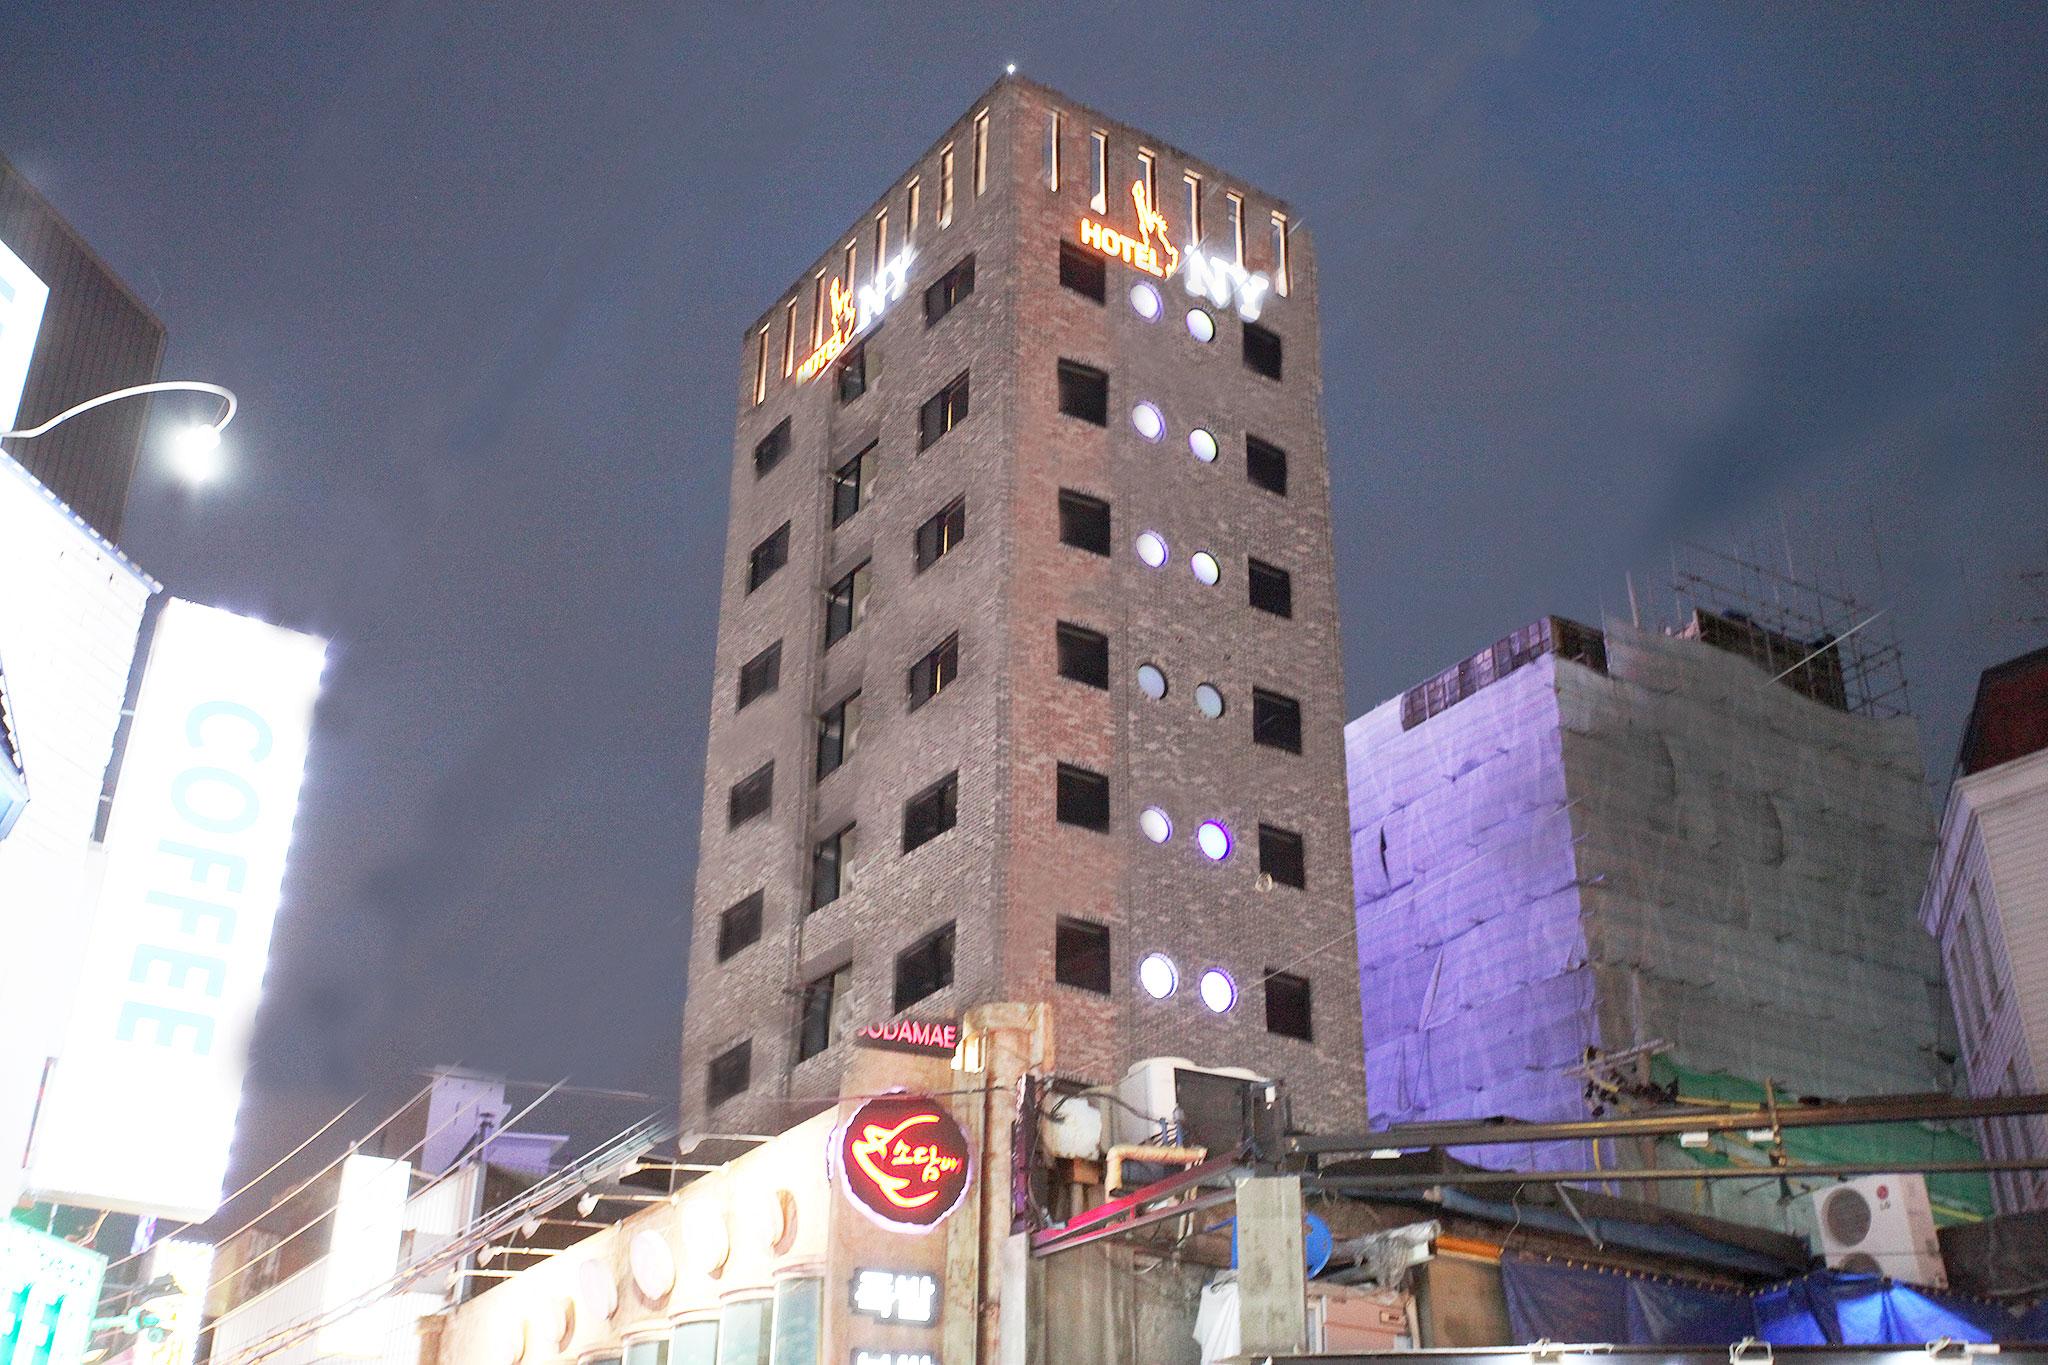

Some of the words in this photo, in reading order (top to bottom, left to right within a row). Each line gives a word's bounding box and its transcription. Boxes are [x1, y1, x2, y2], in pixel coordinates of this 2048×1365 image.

[858, 250, 911, 335] NY
[1081, 217, 1165, 279] HOTEL
[1184, 244, 1270, 321] NY
[115, 699, 273, 1057] COFFEE
